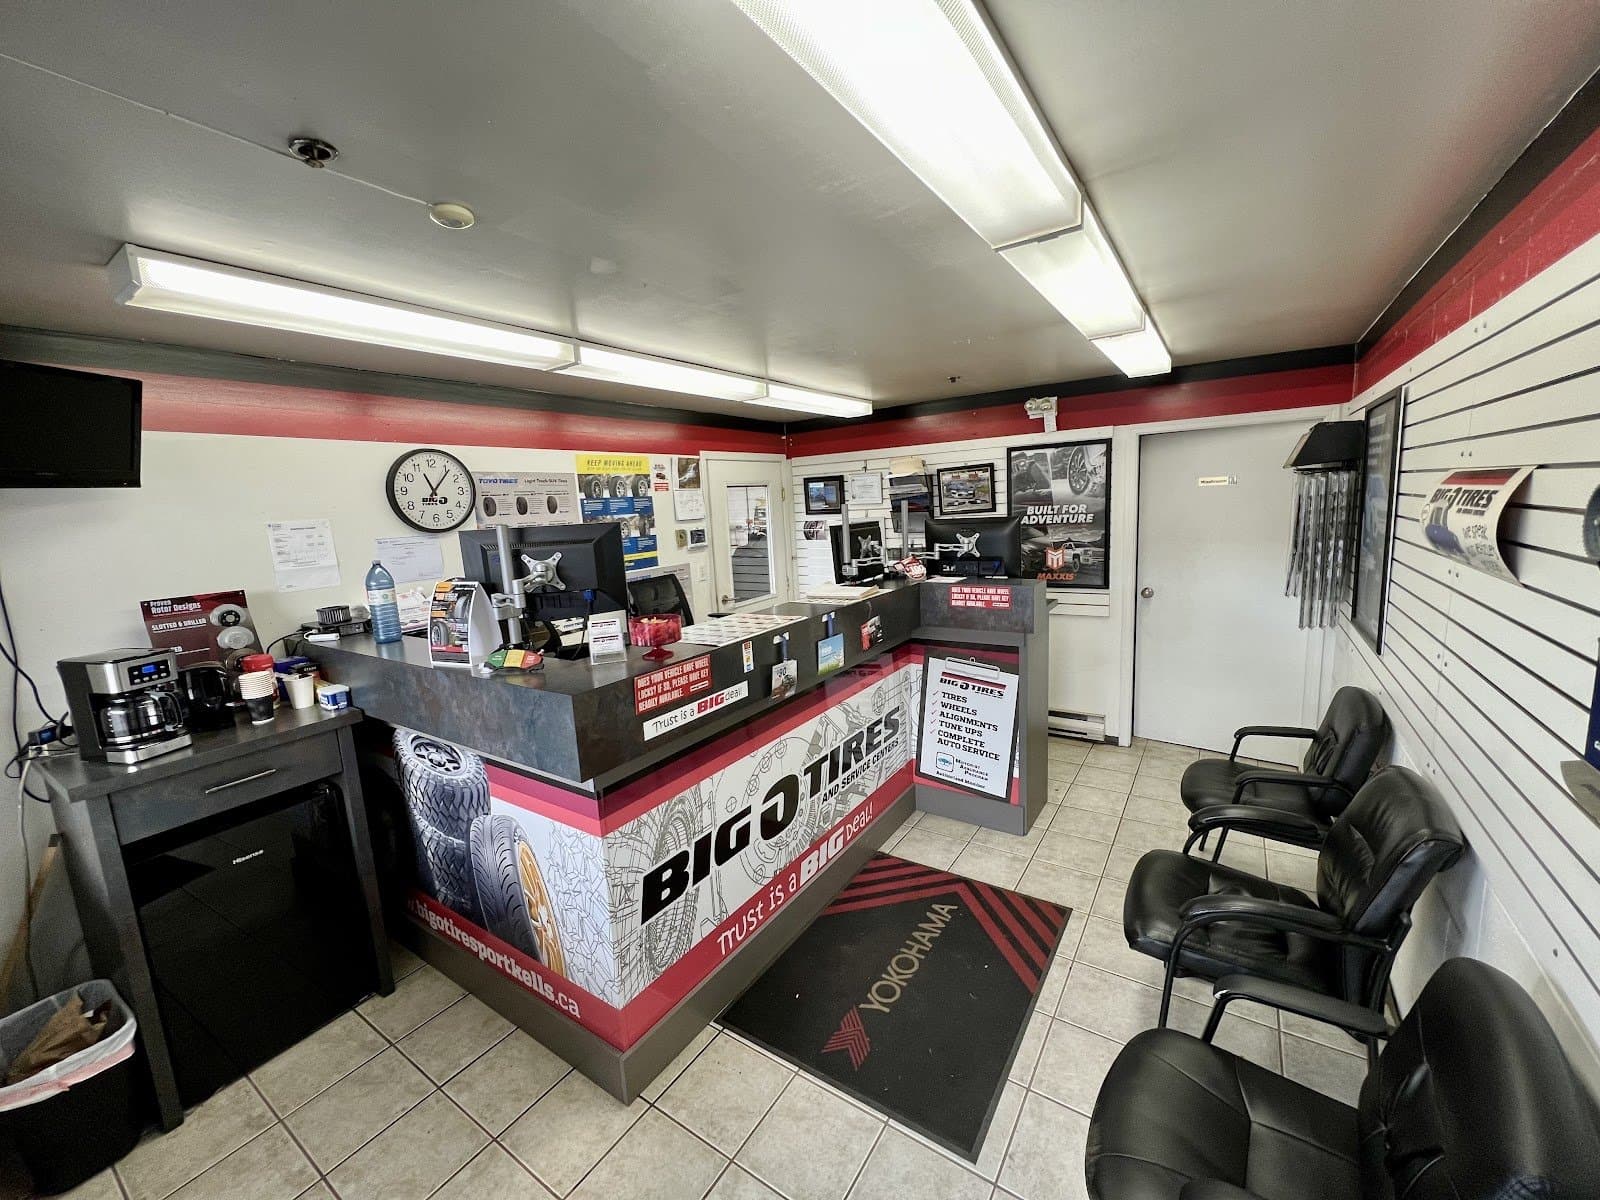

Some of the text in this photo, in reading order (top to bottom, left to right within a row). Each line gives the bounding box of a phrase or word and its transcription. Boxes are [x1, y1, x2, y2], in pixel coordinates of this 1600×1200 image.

[413, 464, 420, 472] 11
[426, 459, 436, 468] 12
[404, 473, 414, 482] 10
[452, 474, 460, 483] 2
[400, 486, 408, 496] 9
[458, 486, 464, 496] 3
[408, 501, 414, 510] 8
[1456, 490, 1499, 508] TIRES
[419, 510, 425, 519] 7
[447, 510, 453, 518] 5
[1027, 504, 1087, 515] BUILT FOR
[433, 514, 440, 523] 6
[1021, 514, 1094, 524] ADVENTURE
[151, 602, 201, 614] Rotor Designs
[152, 622, 177, 631] SLOTTED
[183, 618, 207, 626] DRILLED
[637, 657, 709, 688] DOES YOUR VEHICLE HAVE WHEEL
[657, 684, 662, 693] IF
[672, 675, 688, 687] PLEASE
[689, 670, 700, 681] HAVE
[700, 668, 709, 678] KEY
[940, 678, 958, 687] BIG
[971, 684, 1005, 697] TIRES
[638, 697, 658, 712] READILY
[941, 691, 968, 704] TIRES
[652, 715, 679, 733] Trust
[680, 709, 688, 720] is
[689, 709, 695, 717] a
[697, 692, 725, 714] BIG
[940, 701, 978, 716] WHEELS
[939, 711, 999, 732] ALIGNMENTS
[939, 721, 983, 737] TUNE UPS
[938, 730, 986, 748] COMPLETE
[937, 738, 1000, 761] AUTO SERVICE
[821, 737, 899, 804] AND SERVICE CENTERS
[641, 706, 900, 926] BIG O TIRES
[768, 882, 786, 911] is
[789, 873, 797, 891] a
[800, 825, 845, 886] BIG
[859, 904, 958, 1013] YOKOHAMA
